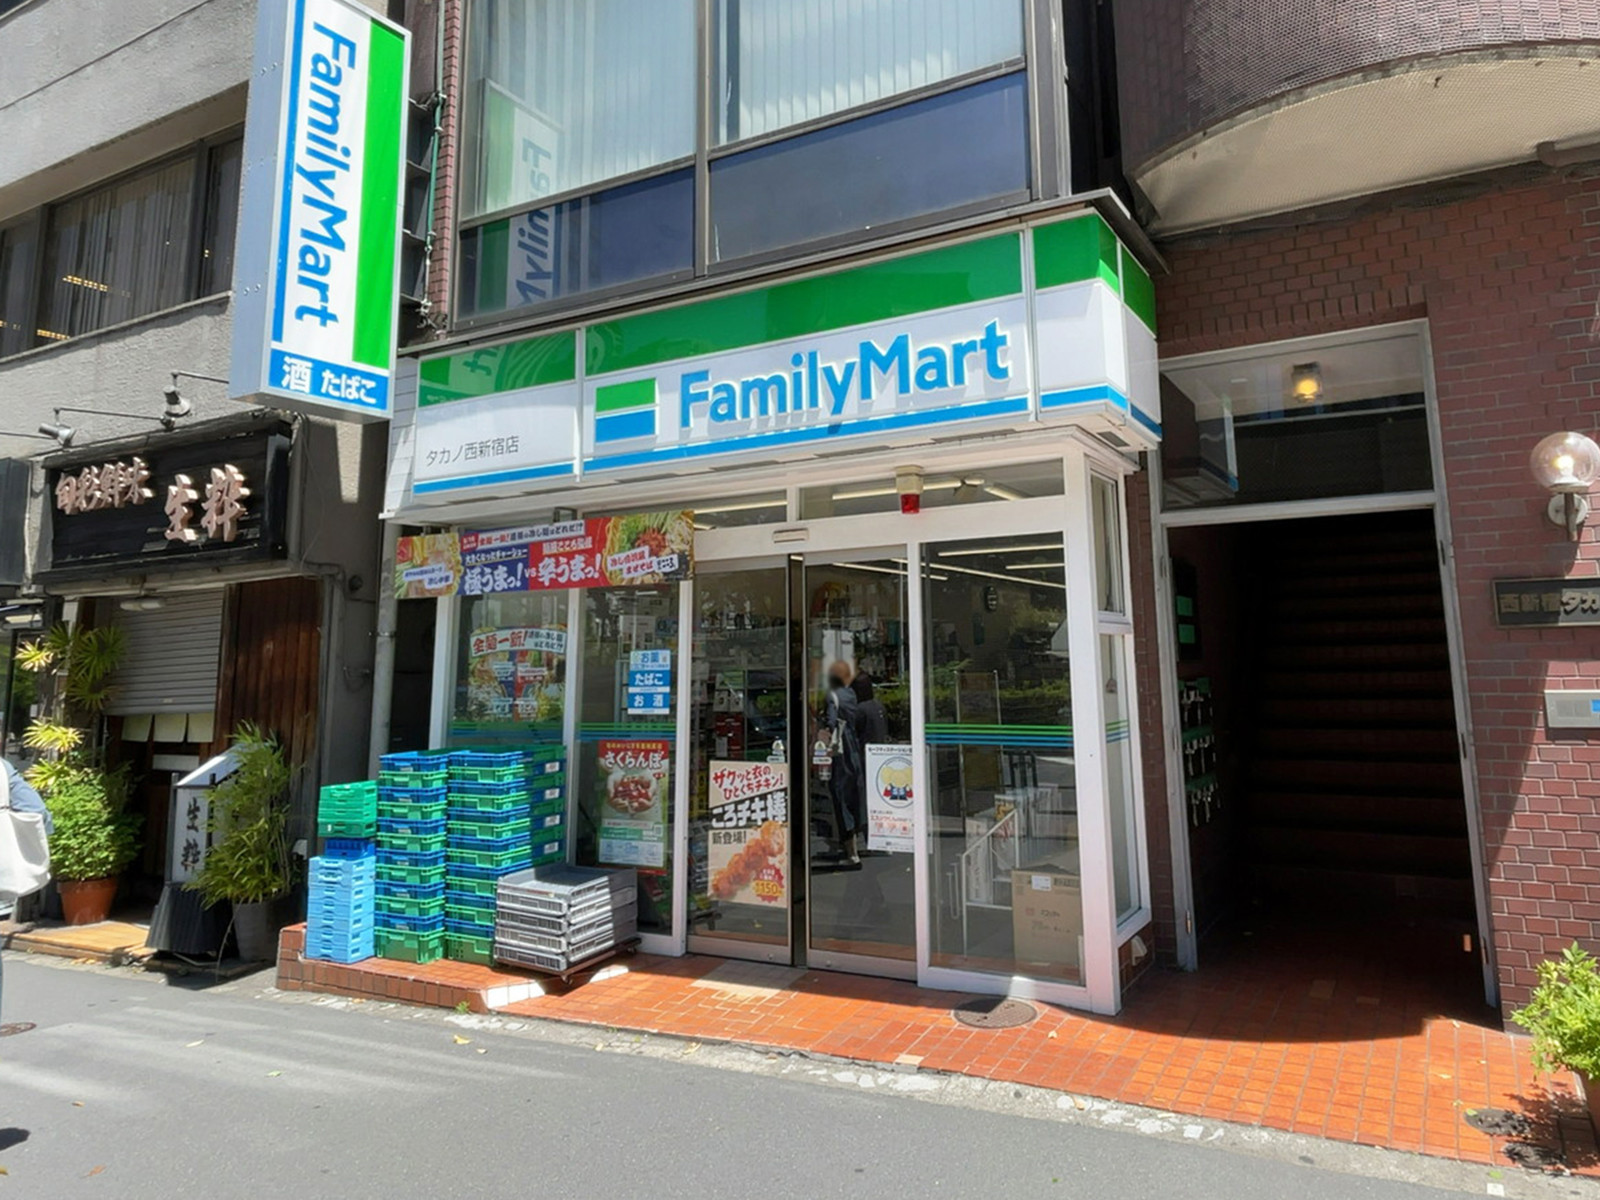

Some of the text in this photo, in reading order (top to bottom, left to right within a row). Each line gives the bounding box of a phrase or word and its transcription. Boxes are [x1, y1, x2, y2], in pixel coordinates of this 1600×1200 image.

[295, 21, 357, 328] FamilyMart
[281, 355, 378, 405] 酒 たばこ
[679, 318, 1011, 429] FamilyMart
[426, 435, 520, 468] タカノ西新宿店
[464, 563, 524, 595] 極うまっ!
[537, 553, 602, 587] 辛うまっ!
[634, 672, 664, 686] たばこ
[633, 694, 664, 708] お酒
[604, 749, 665, 769] さくらんぼ
[712, 765, 773, 788] ザクッと衣の
[723, 774, 784, 800] ひとくちチキン!
[711, 794, 788, 829] ころチキ棒
[712, 830, 747, 846] 新登場!
